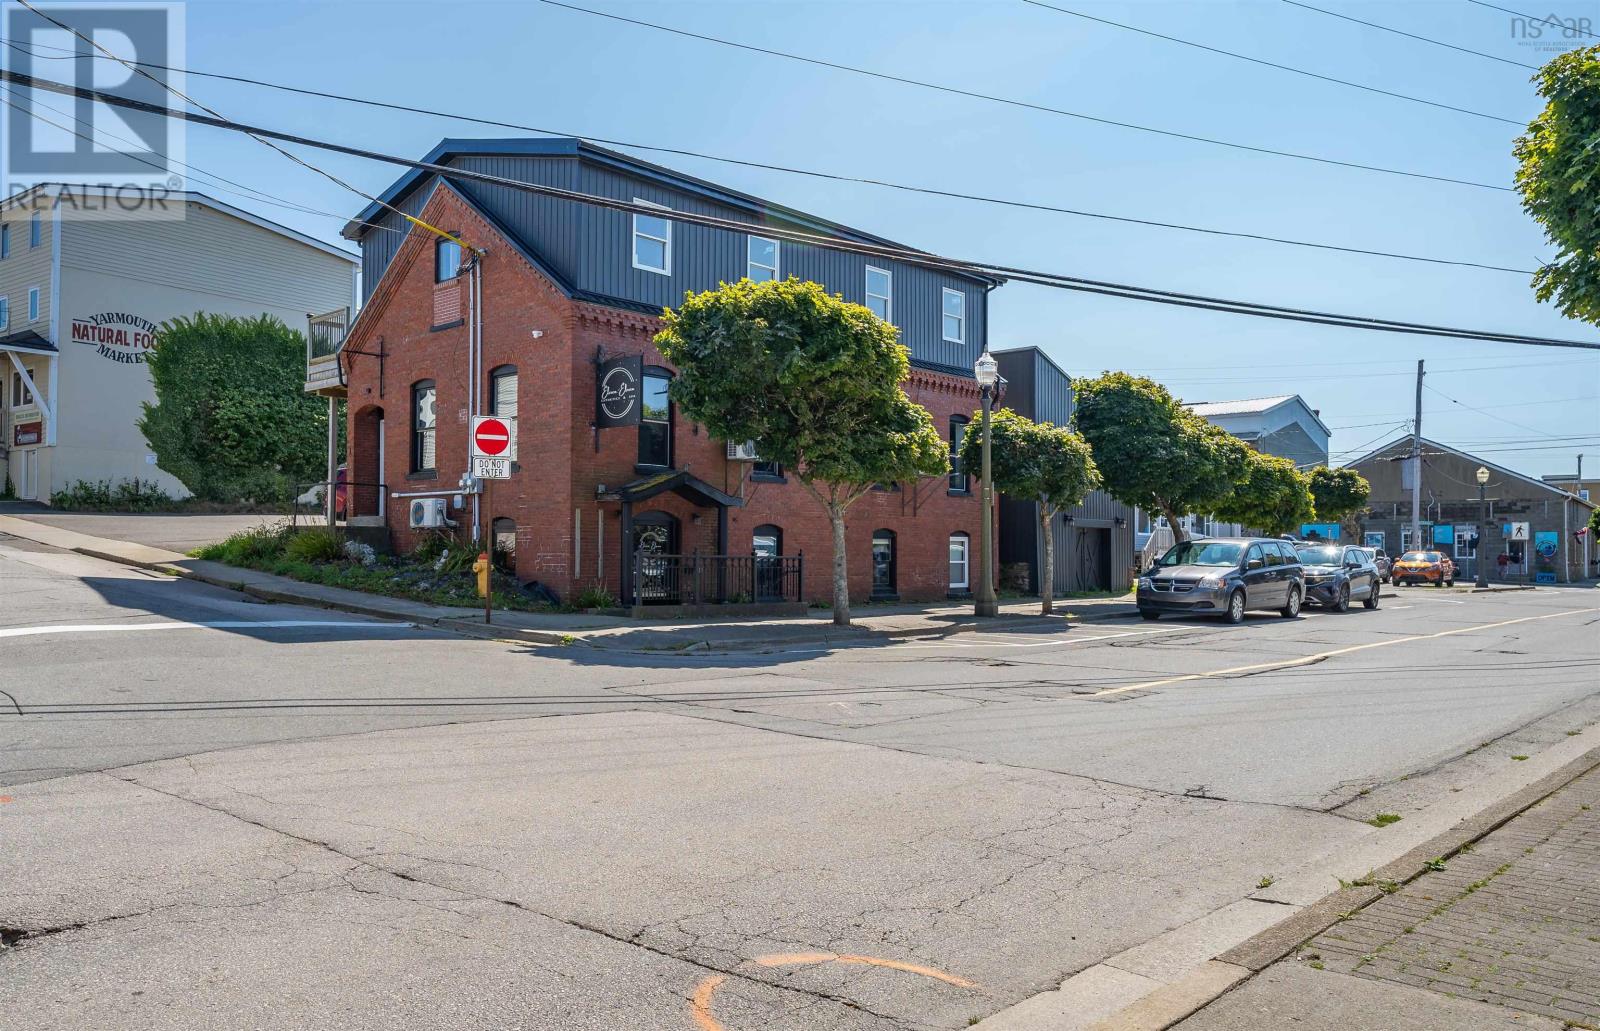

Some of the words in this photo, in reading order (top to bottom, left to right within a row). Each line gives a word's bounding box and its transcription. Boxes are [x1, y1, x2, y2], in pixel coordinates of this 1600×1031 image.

[89, 311, 157, 334] YARMOUTH
[72, 322, 130, 346] NATURAL
[133, 332, 159, 350] FOO
[479, 460, 489, 468] DO
[491, 460, 505, 469] NOT
[481, 467, 503, 477] ENTER
